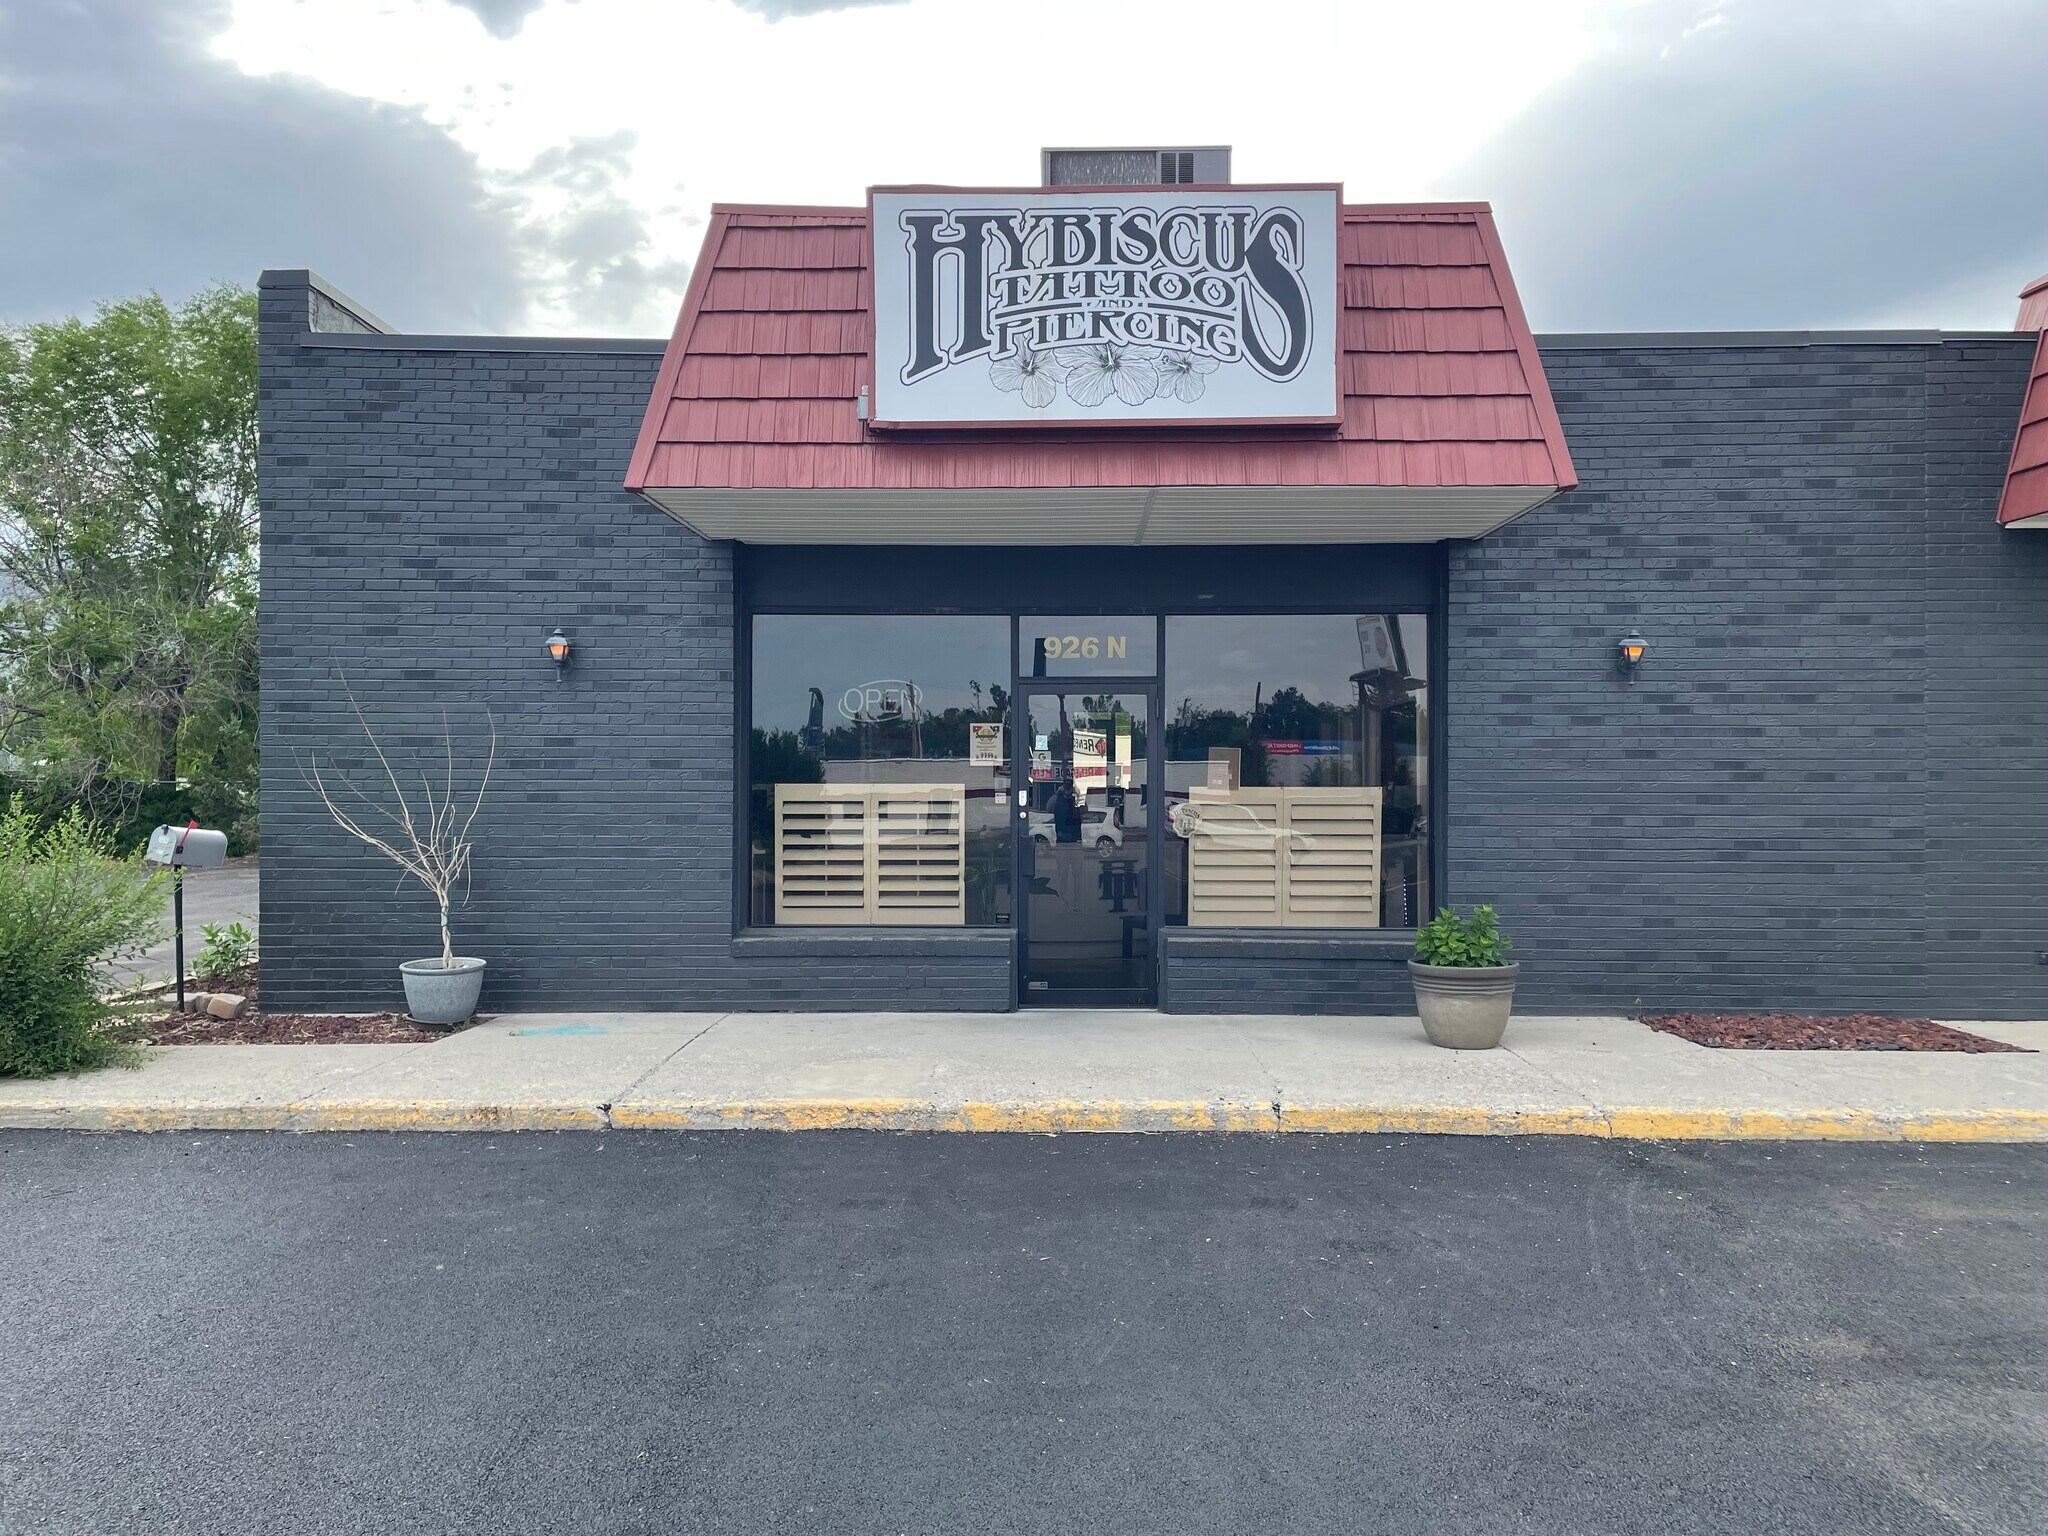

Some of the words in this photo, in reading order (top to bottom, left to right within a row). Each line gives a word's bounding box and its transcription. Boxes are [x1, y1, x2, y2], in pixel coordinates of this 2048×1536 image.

[903, 211, 1307, 379] HYBISCUS
[995, 270, 1236, 308] TATTOO
[1093, 299, 1134, 309] AND
[995, 311, 1237, 357] PIERCING
[1043, 635, 1100, 660] 926
[1106, 635, 1127, 660] N
[843, 688, 918, 714] OPEN
